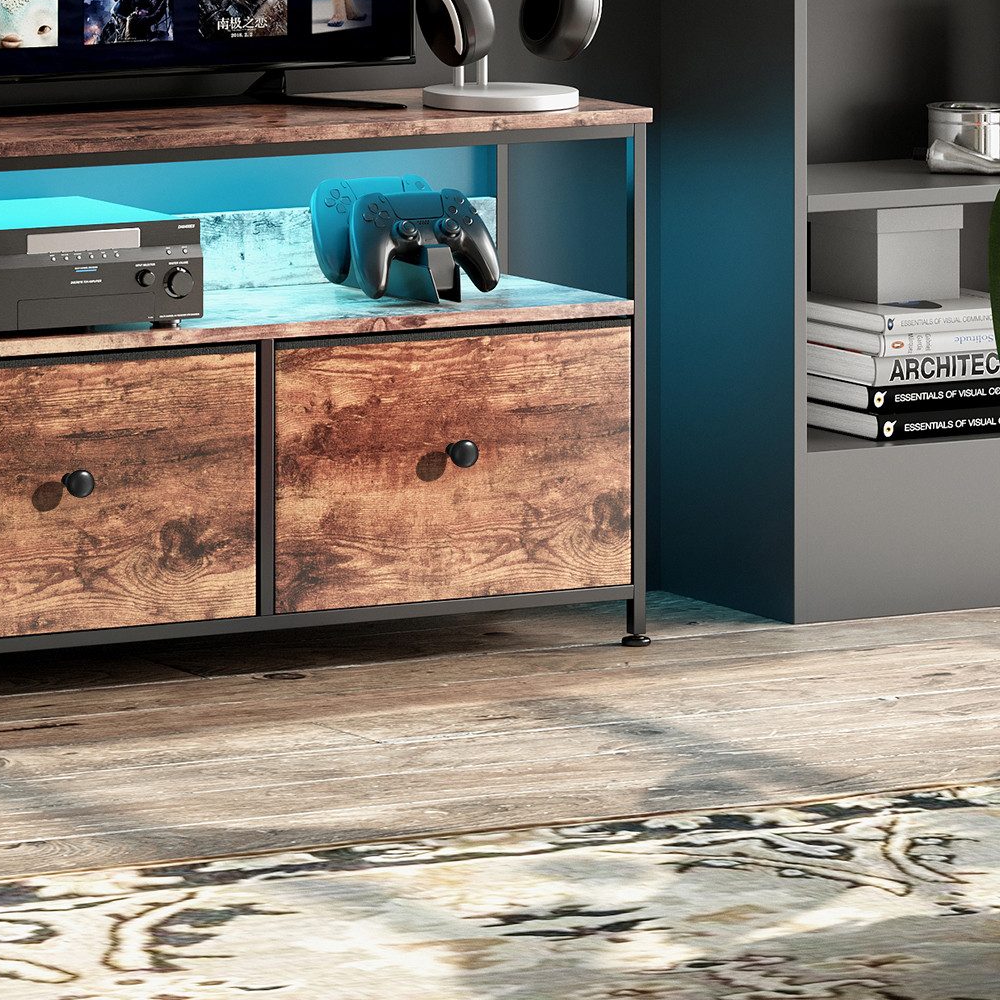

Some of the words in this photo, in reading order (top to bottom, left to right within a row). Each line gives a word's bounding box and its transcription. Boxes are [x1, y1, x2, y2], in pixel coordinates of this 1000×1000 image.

[901, 318, 933, 327] ESSENTIALS
[934, 317, 942, 325] OF
[943, 316, 962, 324] VISUAL
[954, 334, 994, 345] Solitude
[890, 352, 1000, 382] ARCHITEC
[894, 391, 944, 402] ESSENTIALS
[945, 389, 957, 399] OF
[958, 388, 987, 398] VISUAL
[904, 420, 953, 431] ESSENTIALS
[955, 419, 967, 428] OF
[968, 417, 996, 427] VISUAL
